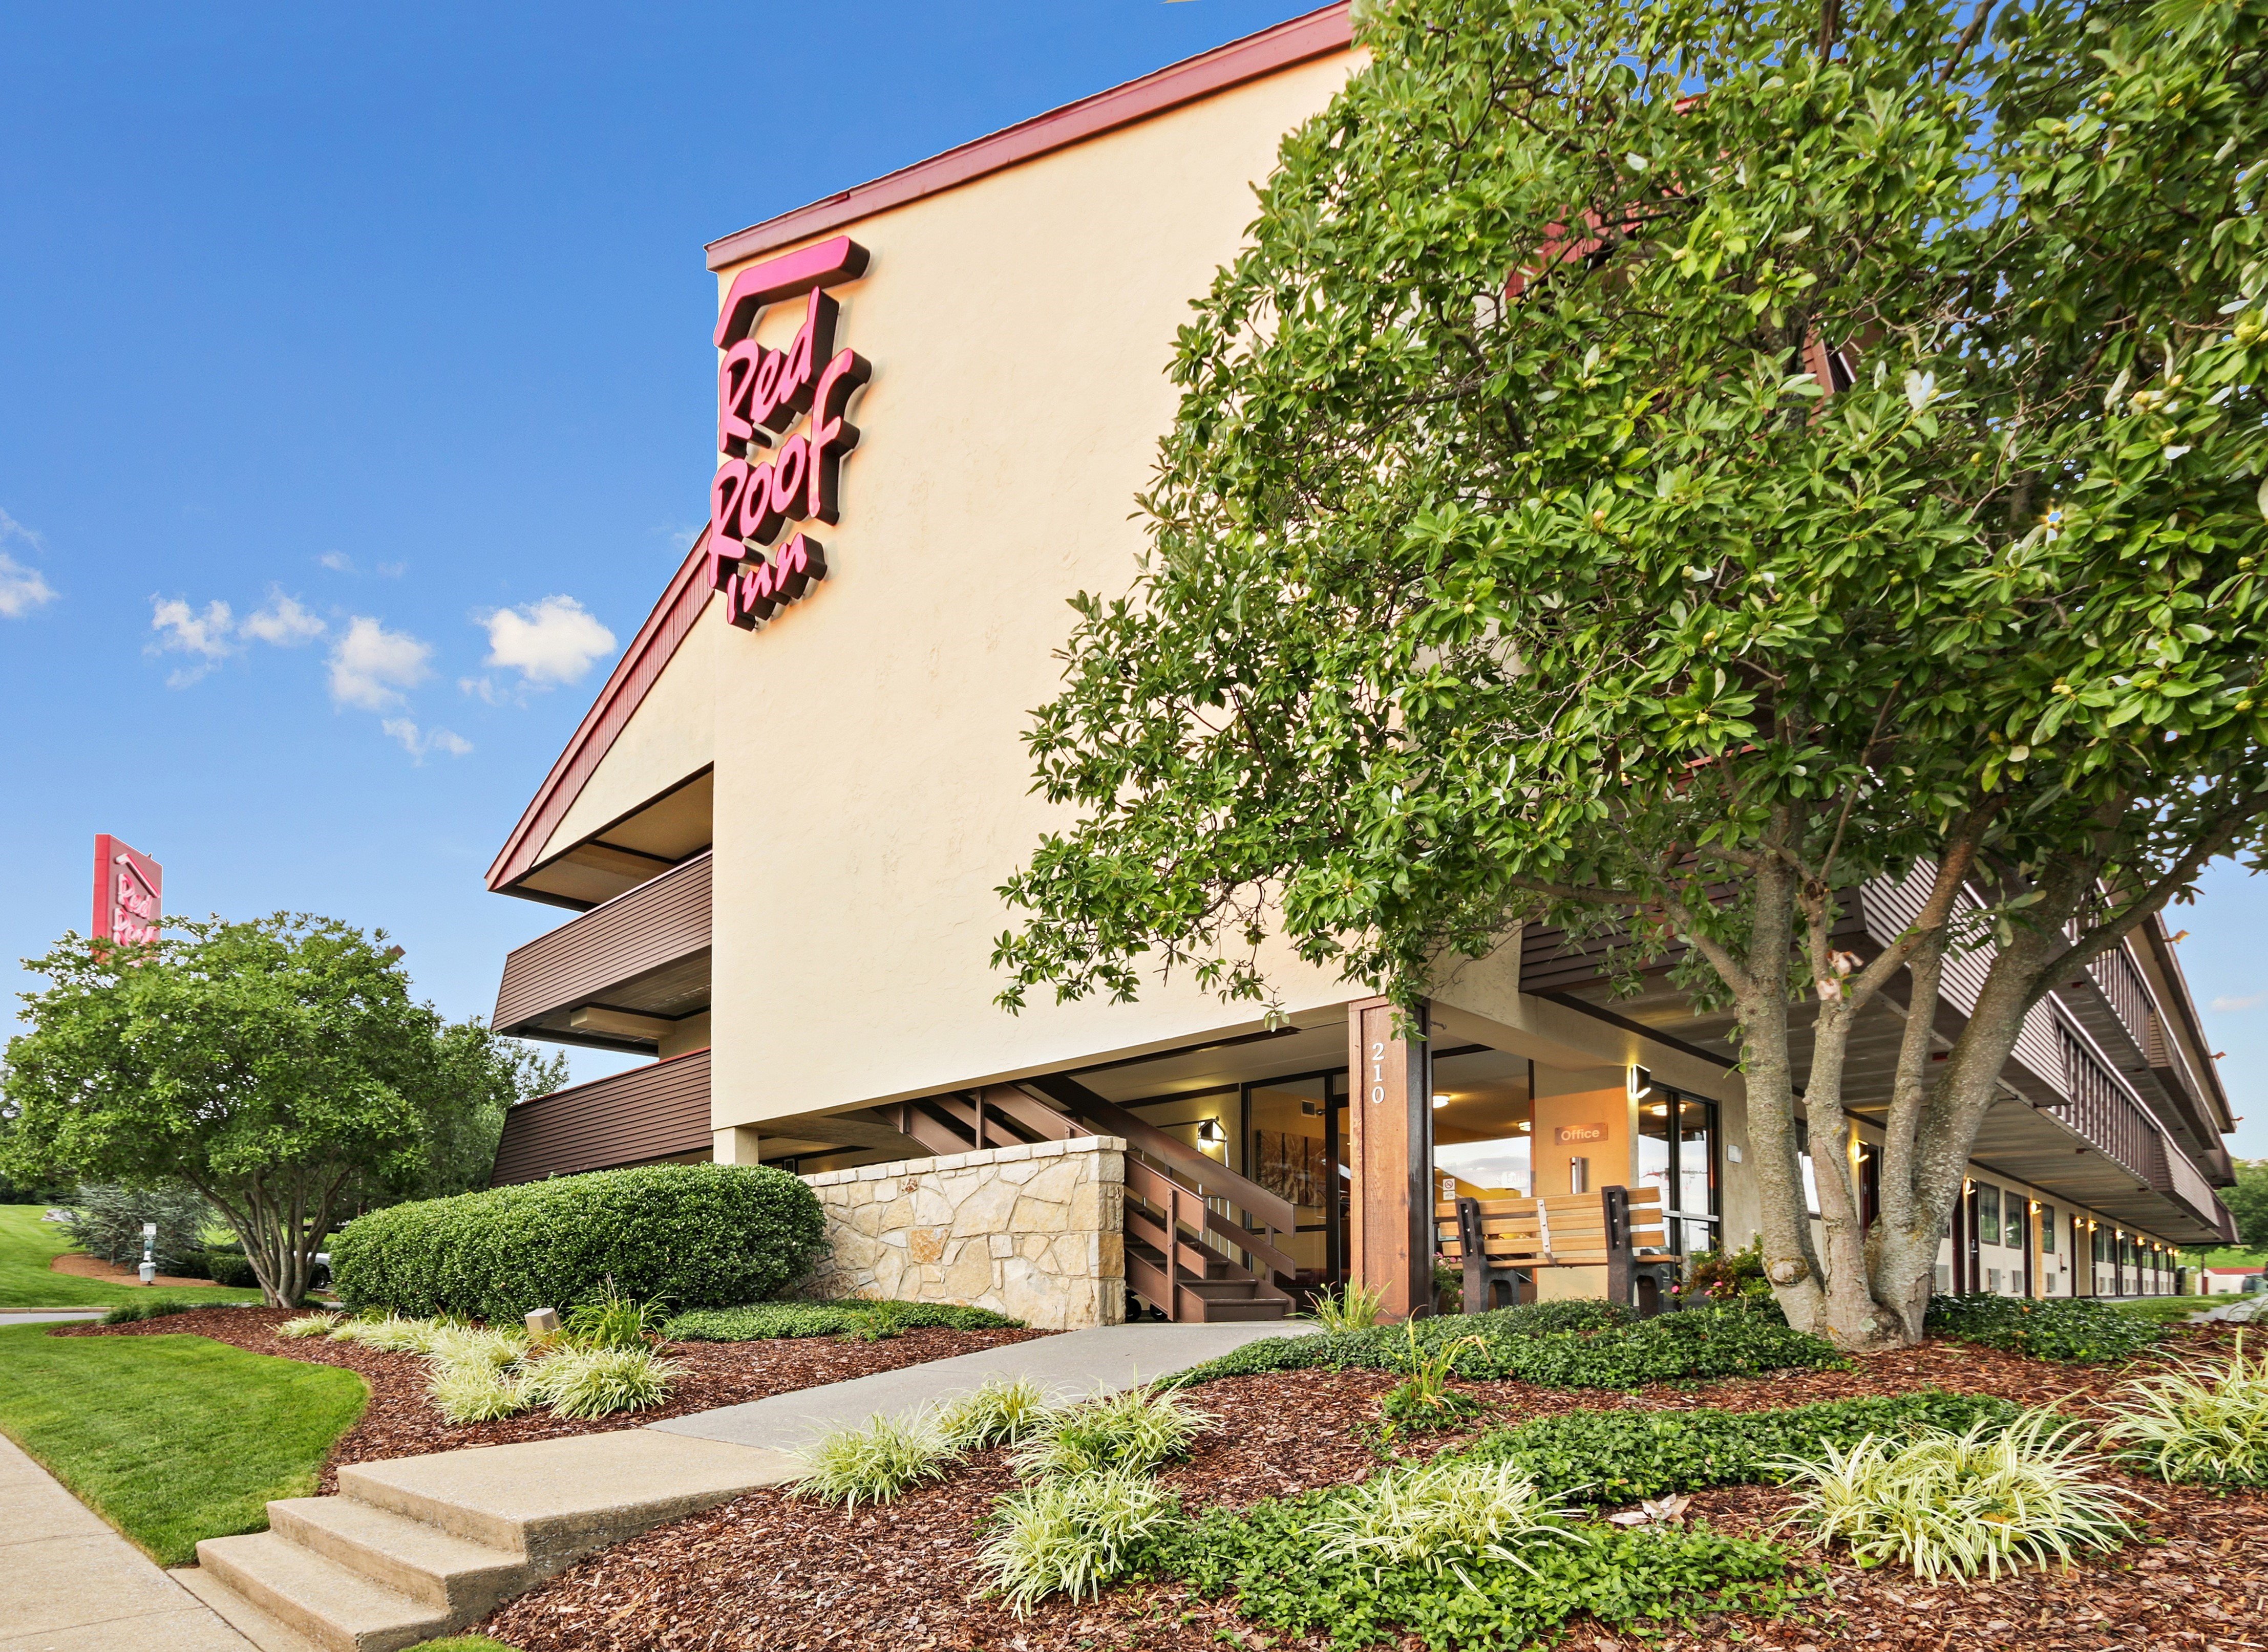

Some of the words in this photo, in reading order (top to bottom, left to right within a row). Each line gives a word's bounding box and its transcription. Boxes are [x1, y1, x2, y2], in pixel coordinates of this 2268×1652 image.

[719, 286, 821, 454] Red
[709, 348, 854, 588] Roof
[727, 532, 809, 626] Inn
[117, 873, 153, 919] Red
[1372, 1042, 1385, 1104] 210
[1561, 1129, 1600, 1141] Office
